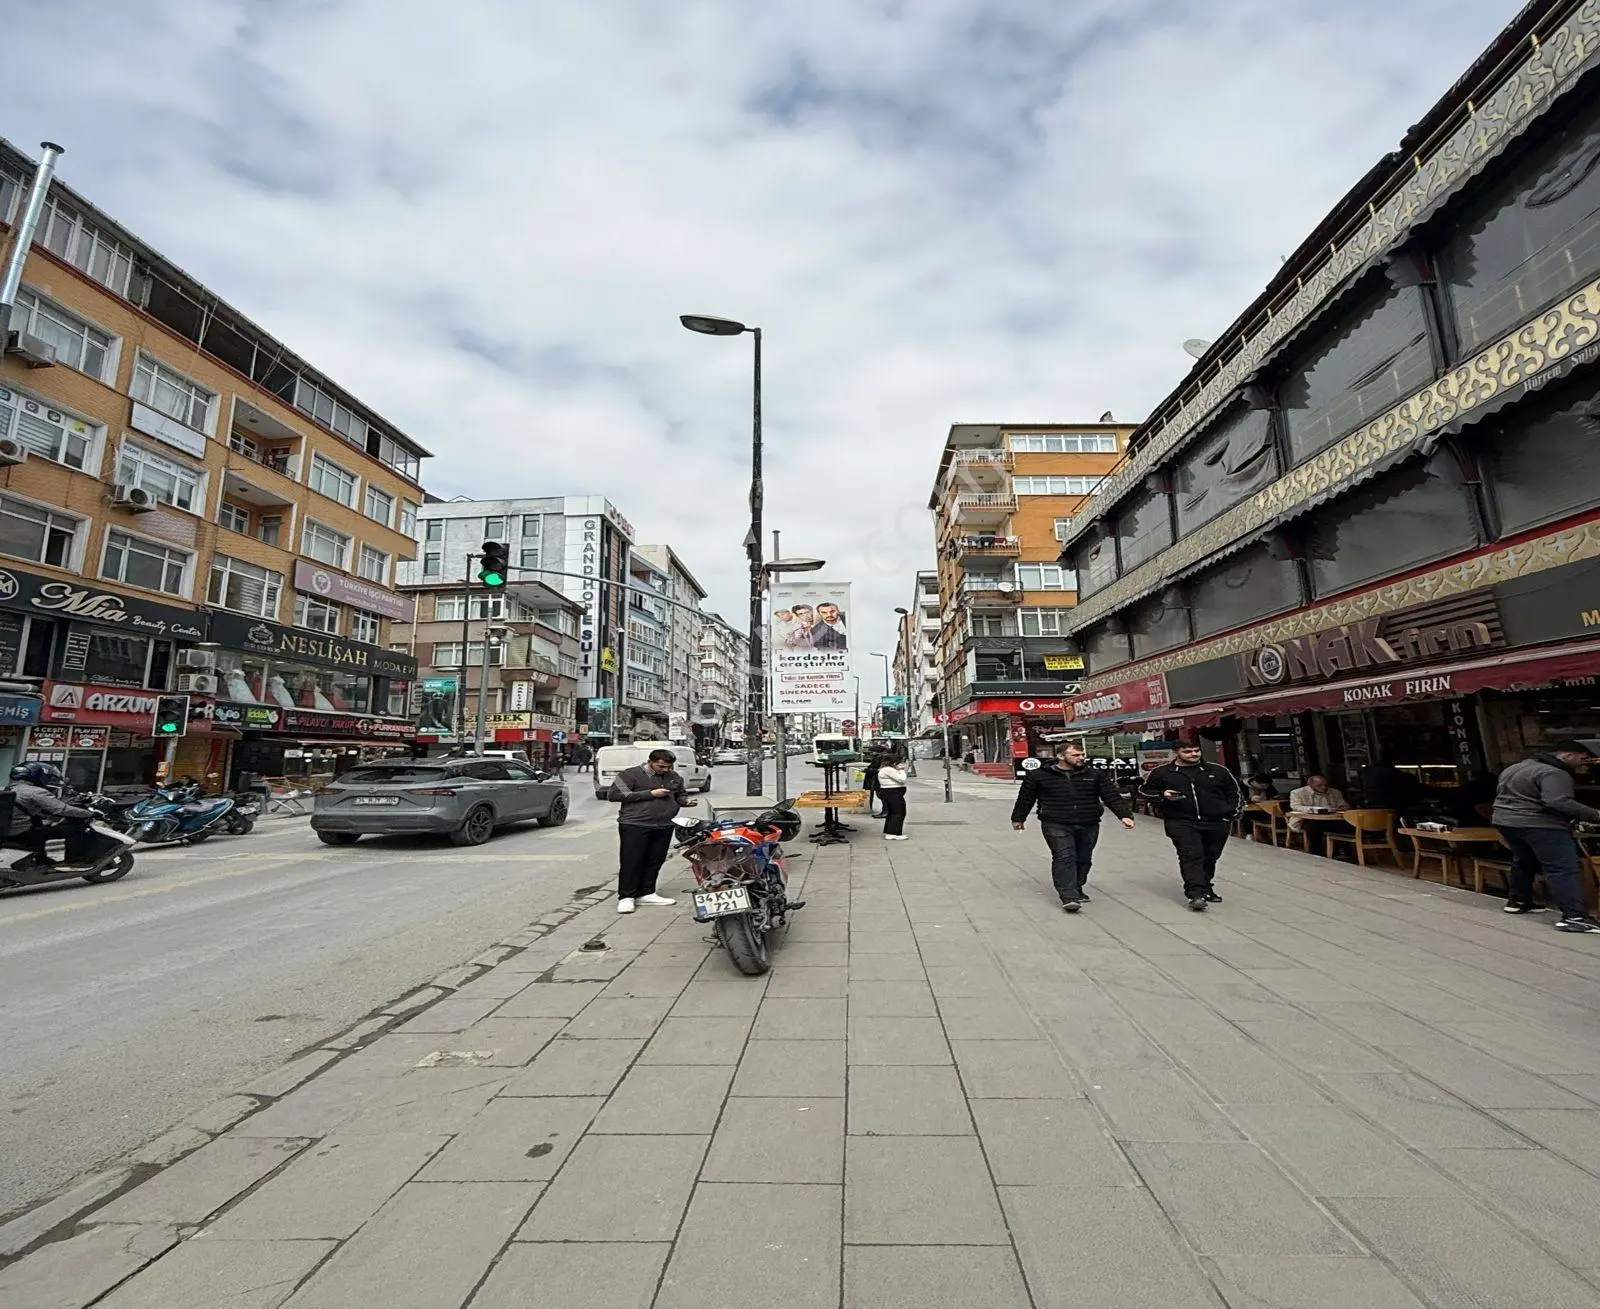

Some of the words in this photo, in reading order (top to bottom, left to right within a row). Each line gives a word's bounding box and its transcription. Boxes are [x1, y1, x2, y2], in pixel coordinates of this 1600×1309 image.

[583, 520, 596, 576] GRAND
[31, 583, 128, 623] Mia
[132, 615, 168, 635] Beauty
[280, 633, 368, 666] NESLİŞAH
[373, 659, 401, 673] MODA
[580, 630, 593, 677] SUIT
[779, 653, 846, 662] kardeşler
[1234, 616, 1401, 688] KONAK
[85, 693, 156, 713] ARZUM
[1343, 683, 1392, 703] KONAK
[1405, 676, 1452, 695] FIRIN
[1451, 702, 1472, 765] KONAK
[697, 894, 713, 904] 34
[715, 889, 744, 901] KVU
[714, 901, 737, 911] 721
